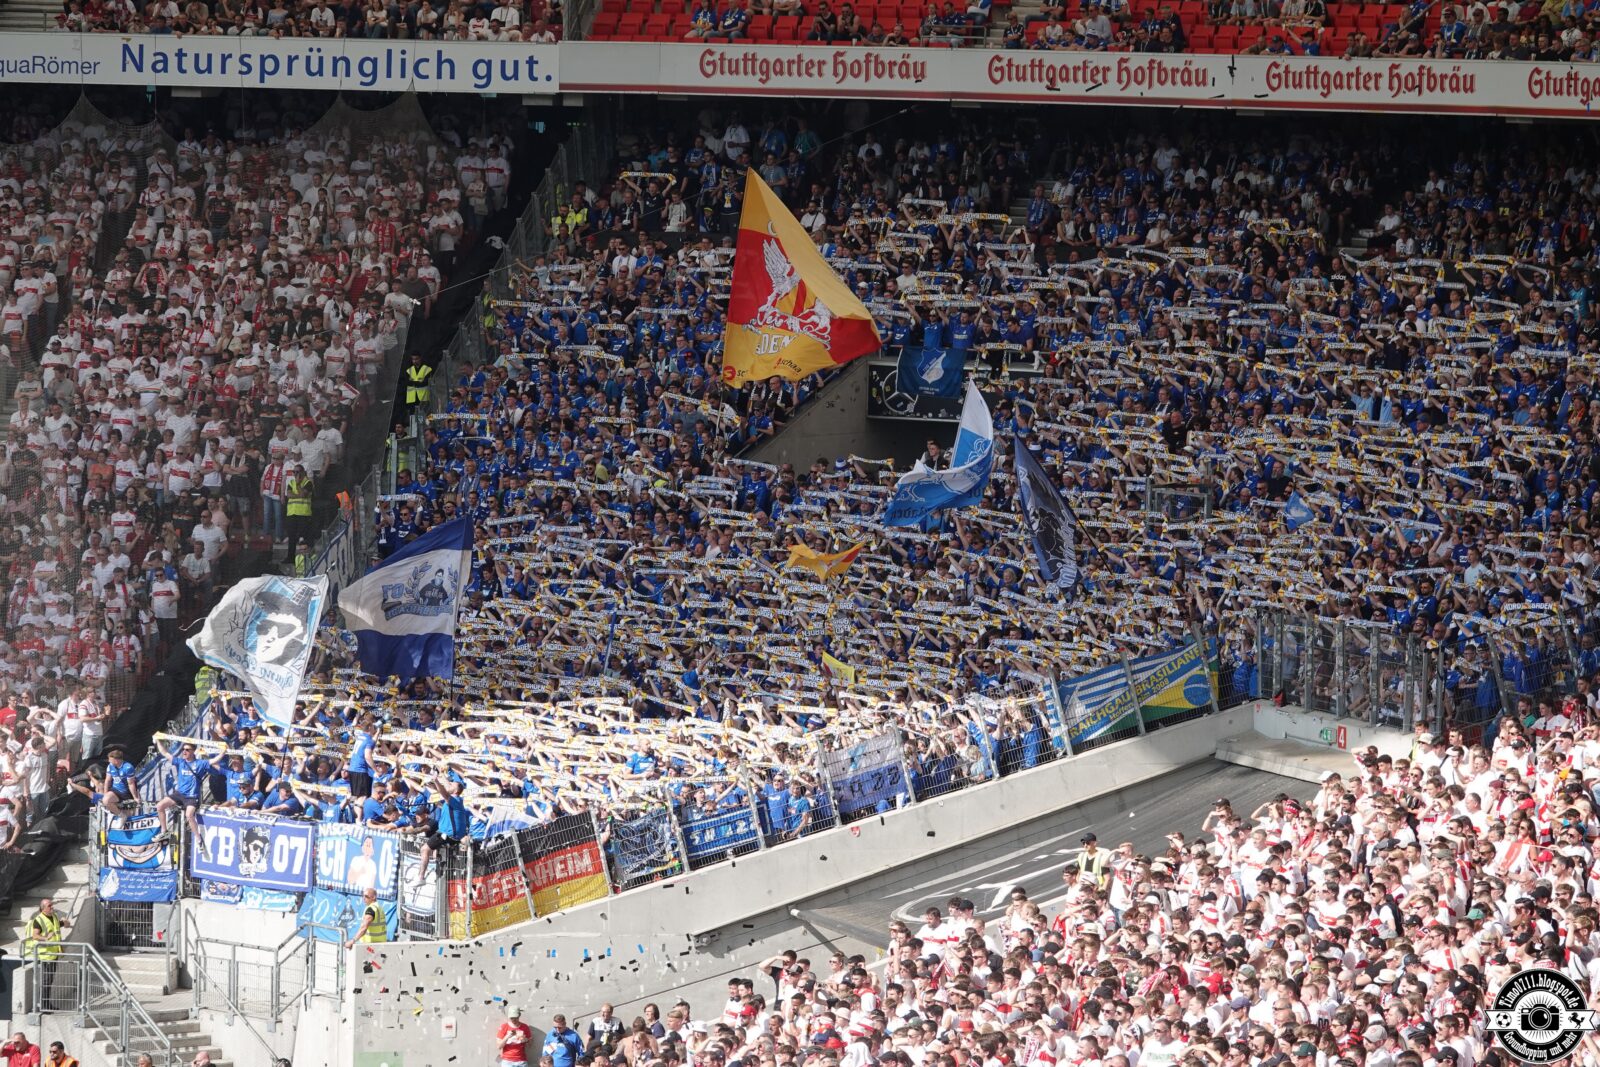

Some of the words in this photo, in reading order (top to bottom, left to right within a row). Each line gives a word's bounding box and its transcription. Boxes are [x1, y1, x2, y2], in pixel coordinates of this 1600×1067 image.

[121, 43, 456, 87] Natursprünglich
[471, 54, 553, 89] gut.
[699, 48, 827, 85] Stuttgarter
[832, 50, 927, 85] Hofbräu
[987, 54, 1111, 89] Stuttgarter
[1116, 57, 1209, 92] Hofbräu
[1265, 60, 1382, 98] Stuttgarter
[1388, 62, 1477, 98] Hofbräu
[1062, 691, 1131, 741] RAICHGAU
[1338, 728, 1345, 747] 4
[122, 819, 154, 831] NITED
[273, 834, 308, 875] 07
